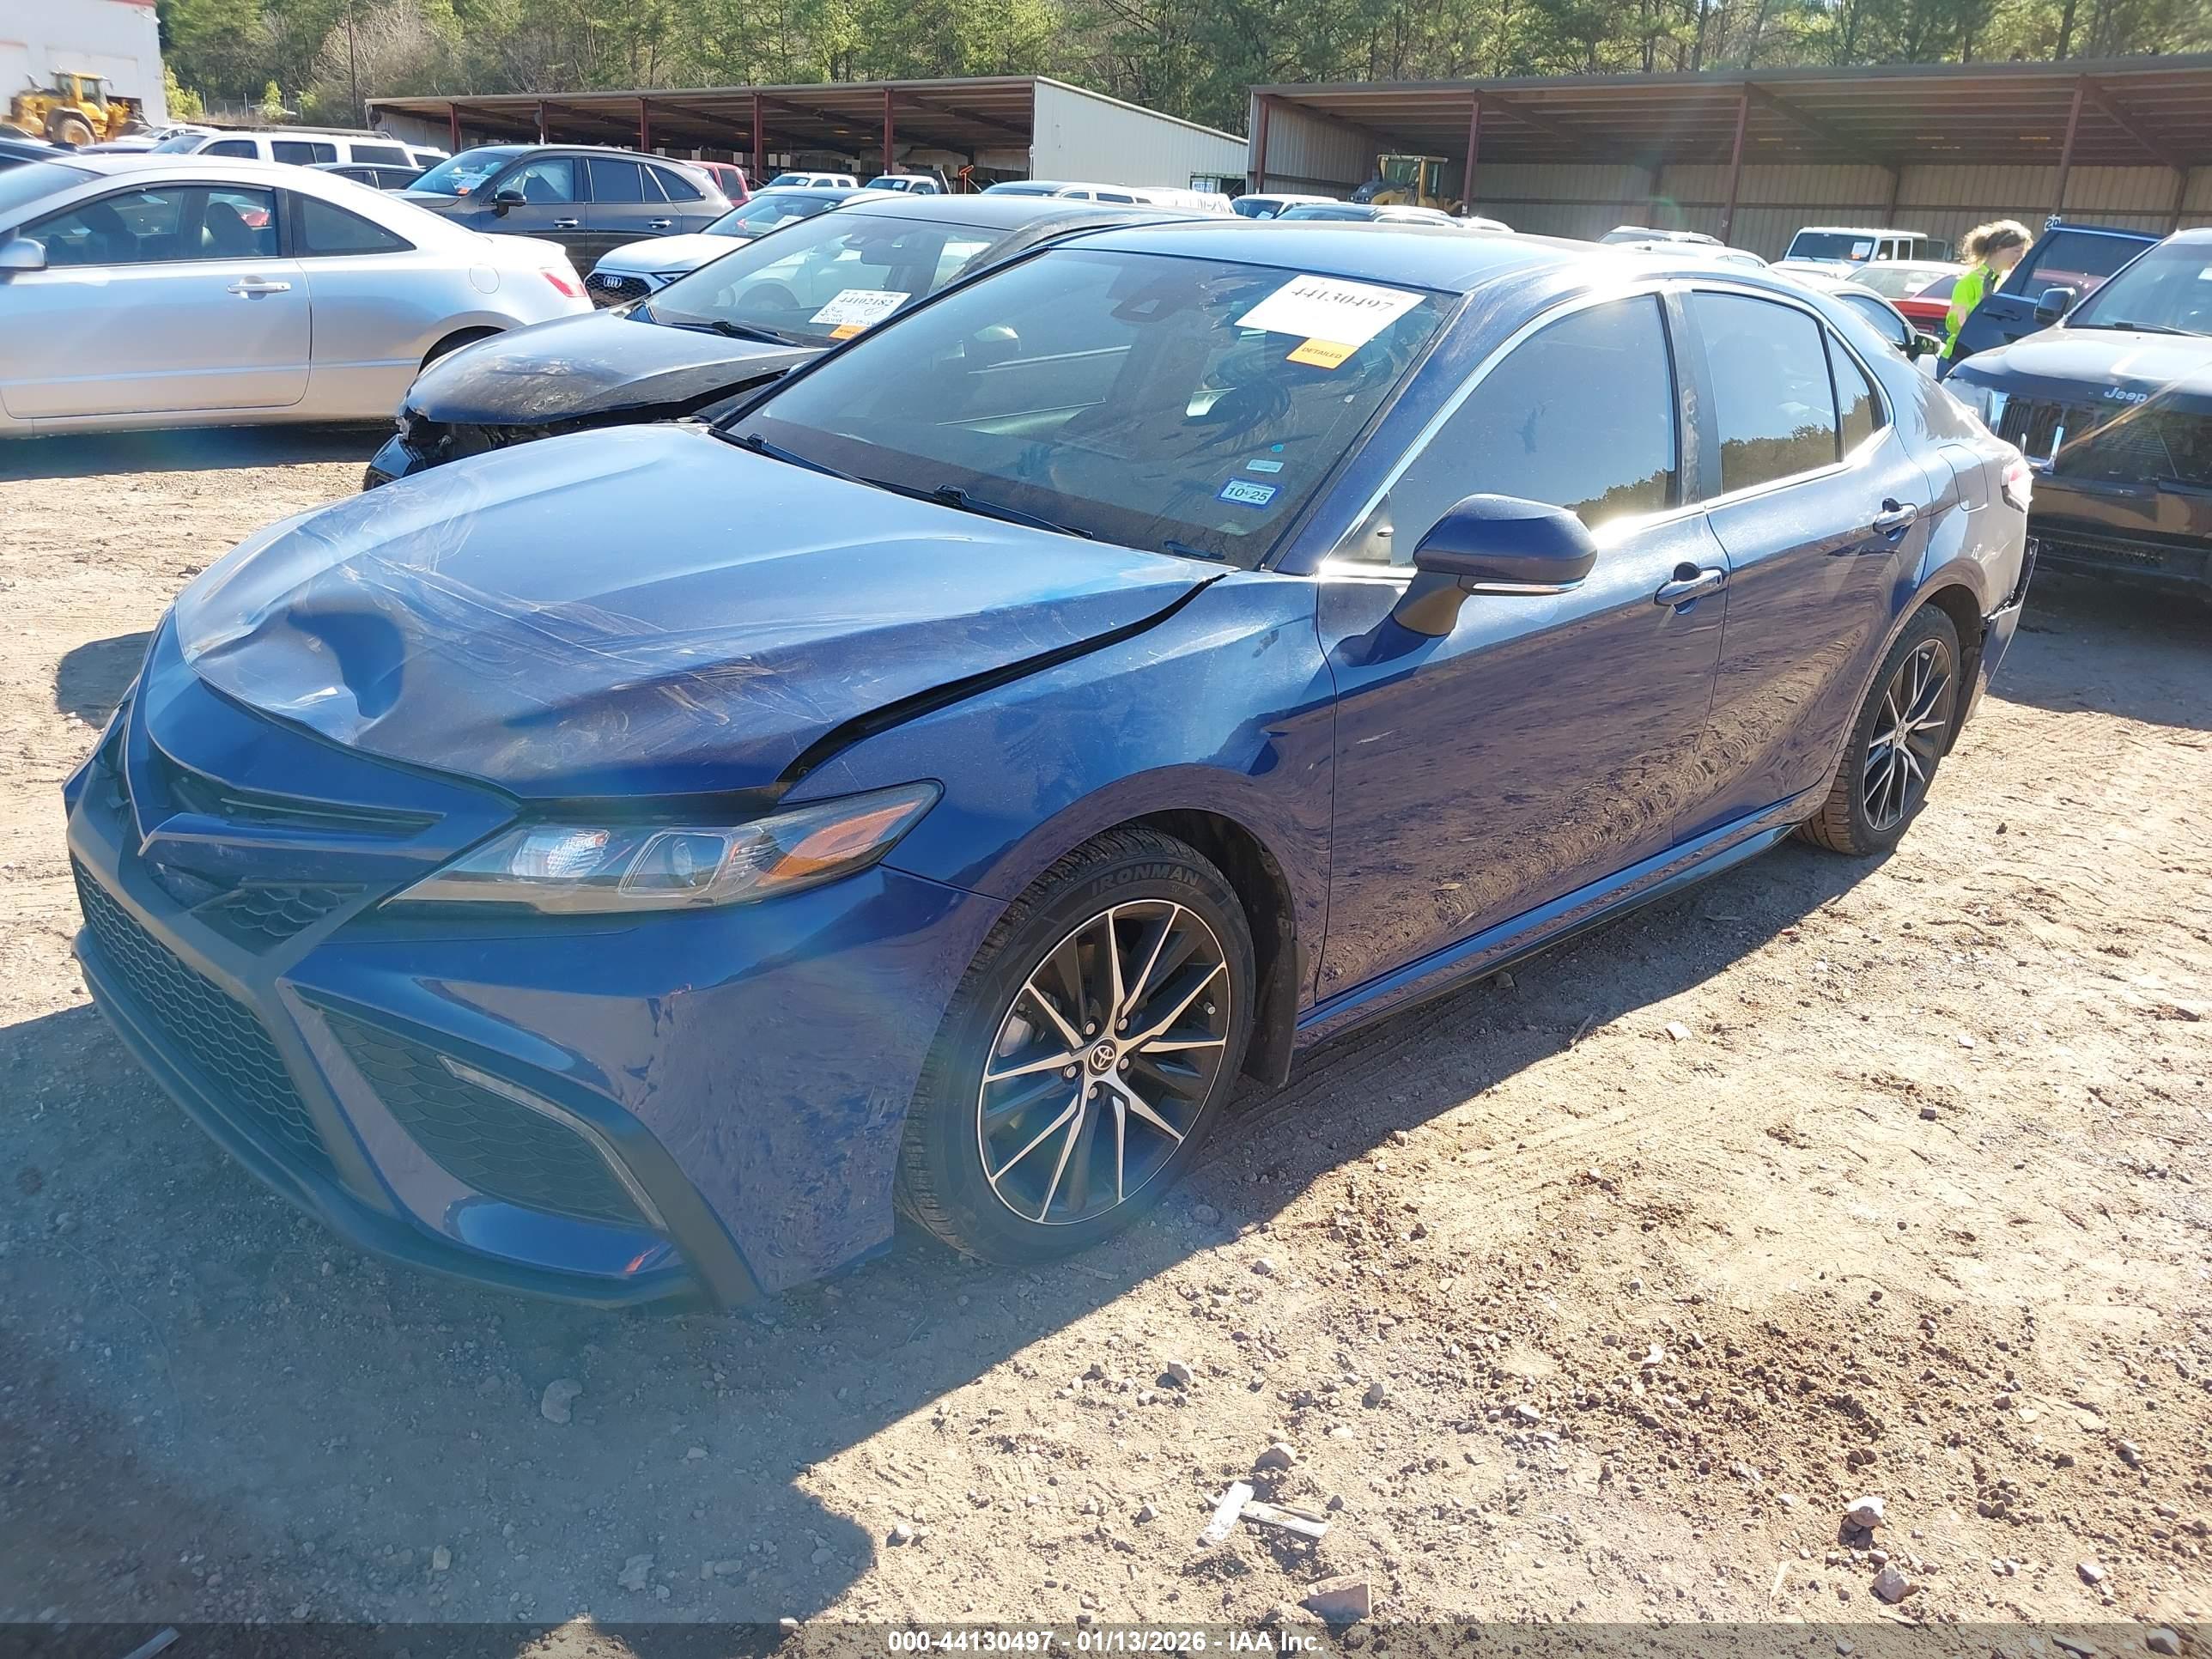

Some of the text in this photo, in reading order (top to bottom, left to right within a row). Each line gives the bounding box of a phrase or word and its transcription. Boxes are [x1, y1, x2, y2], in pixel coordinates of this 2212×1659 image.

[2045, 218, 2060, 229] 20
[1291, 288, 1395, 312] 44130497
[1301, 347, 1343, 360] DETAILED
[2104, 386, 2148, 404] Jeep
[1091, 864, 1200, 896] IRONMAN
